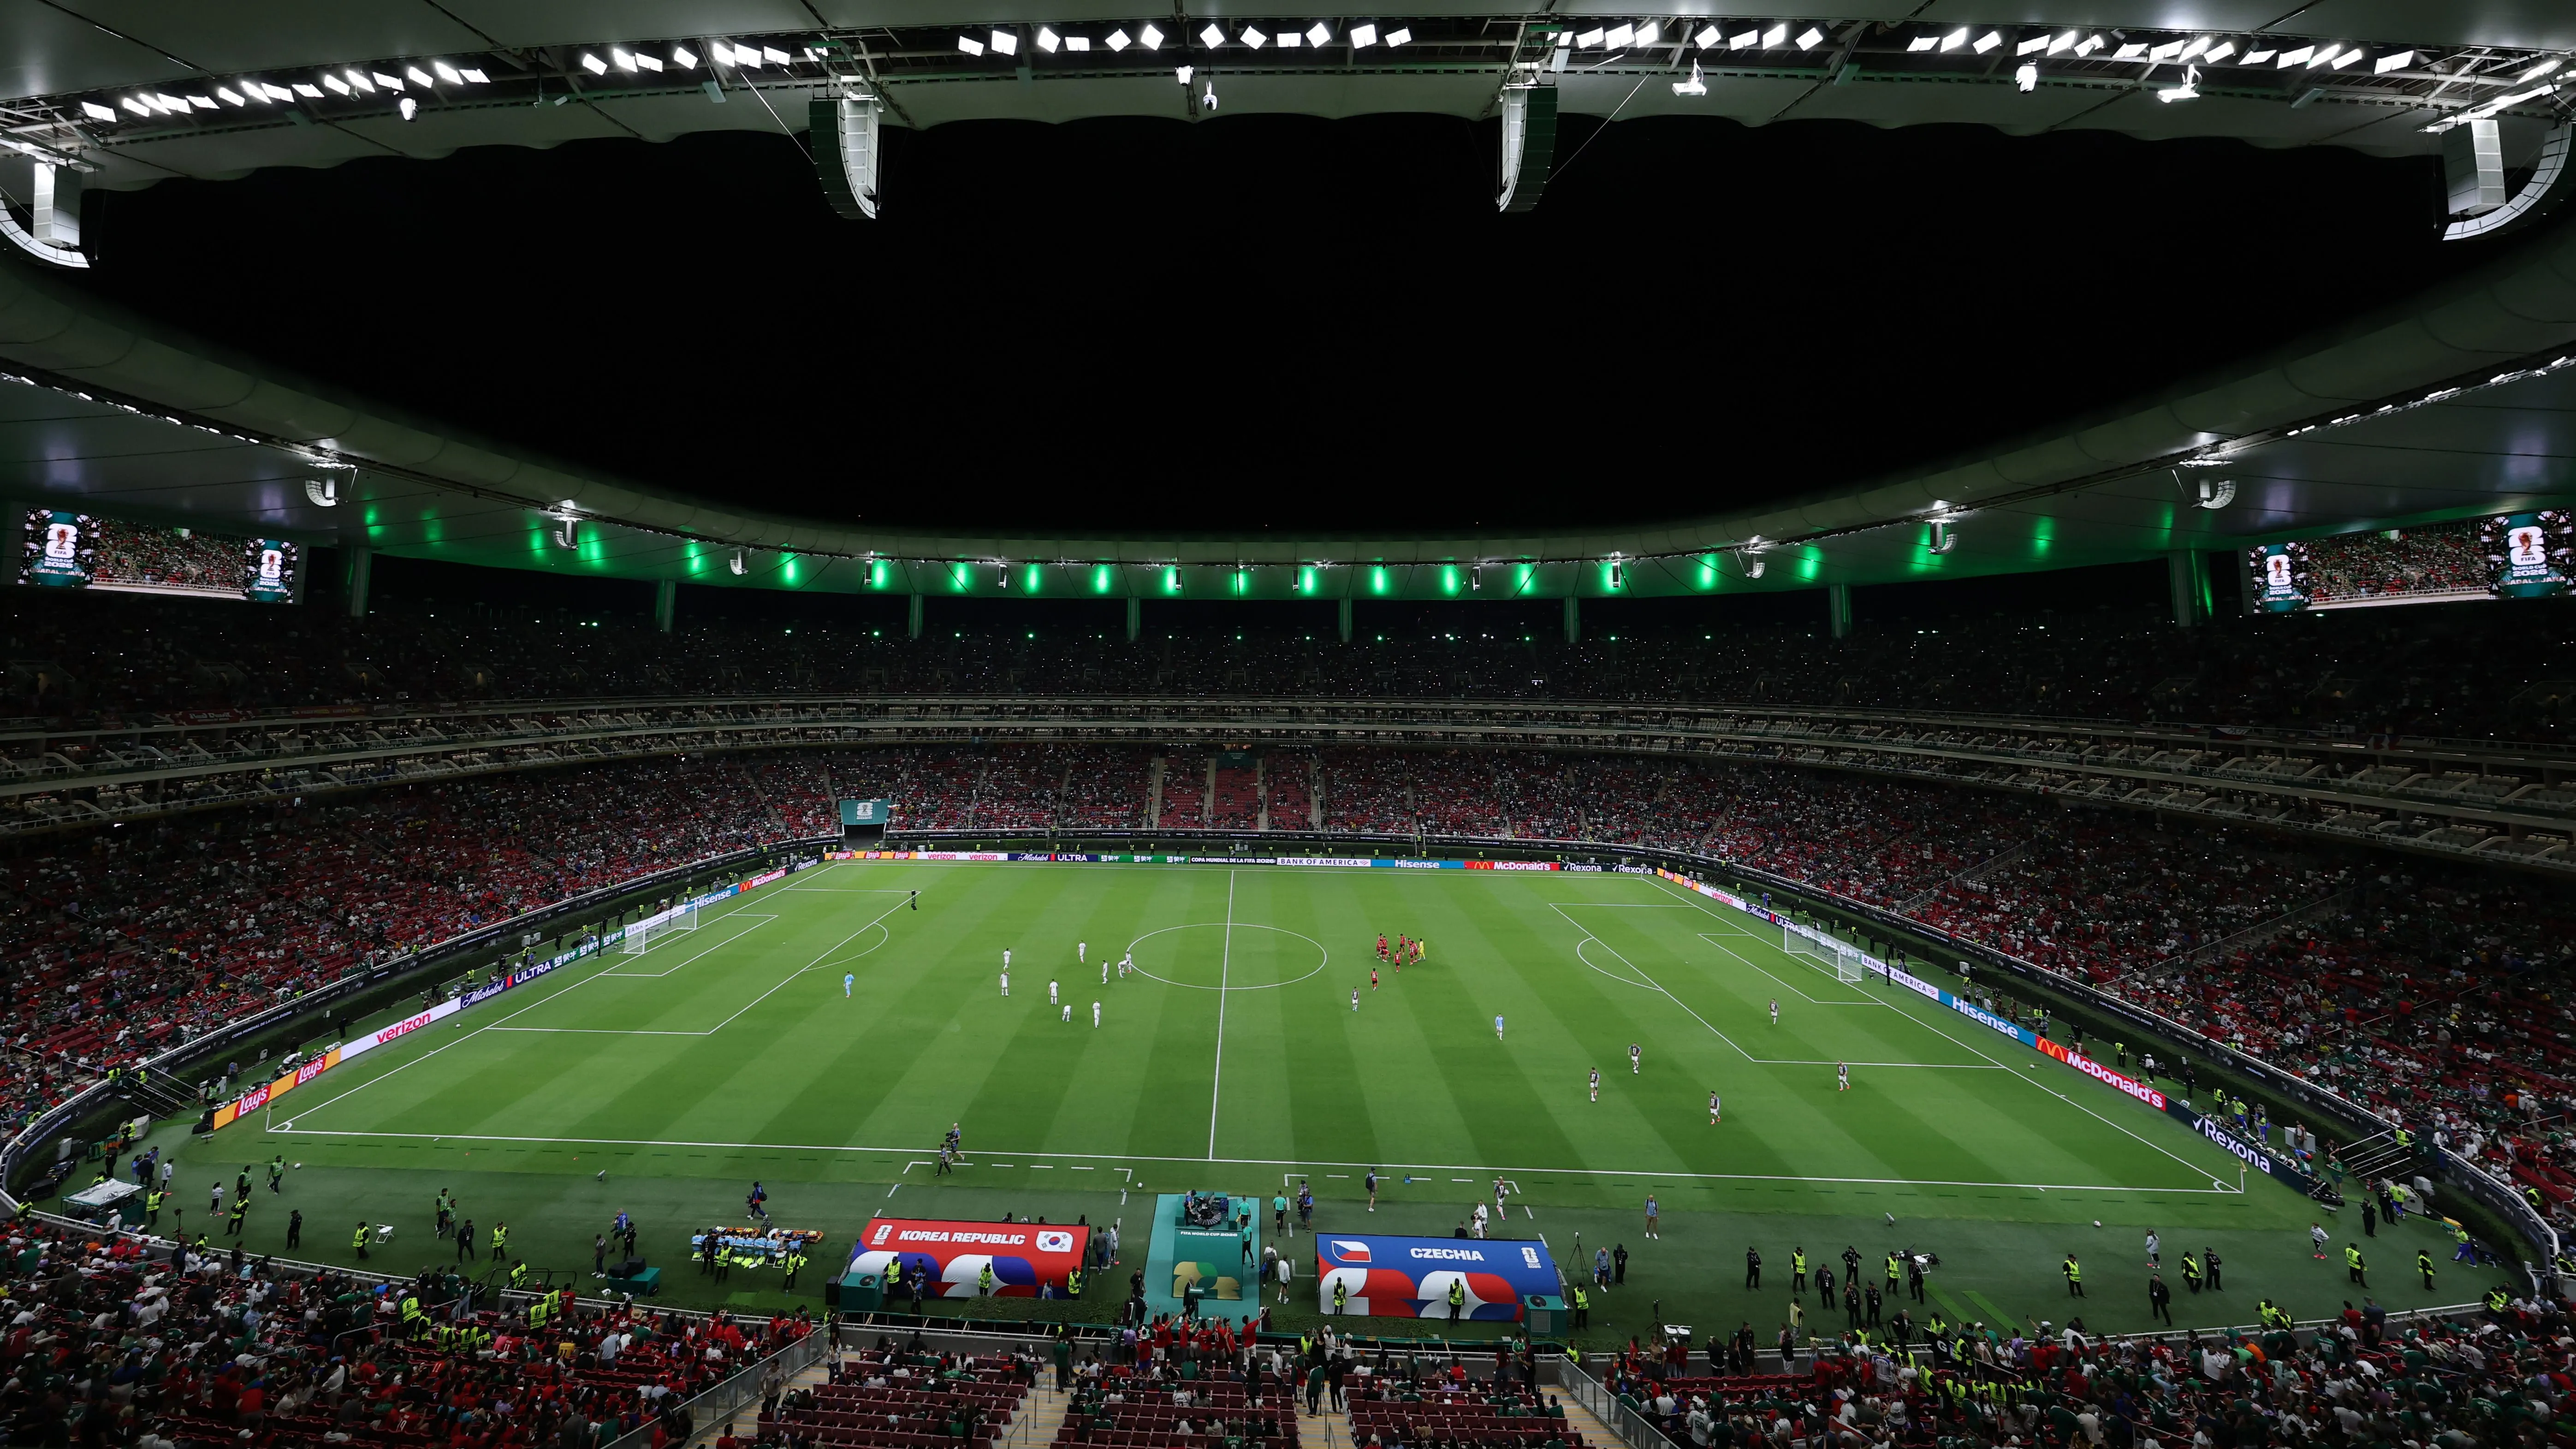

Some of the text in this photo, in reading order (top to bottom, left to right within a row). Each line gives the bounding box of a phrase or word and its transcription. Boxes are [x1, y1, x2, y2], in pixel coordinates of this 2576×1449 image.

[2202, 772, 2275, 784] GUADALAJARA
[798, 859, 817, 871] Rexona
[1395, 860, 1440, 868] Hisense
[1494, 861, 1550, 870] McDonald's
[1570, 863, 1602, 872] Rexona
[752, 869, 785, 888] McDonald's
[694, 890, 731, 909] Hisense
[1712, 891, 1733, 906] verizon
[1747, 905, 1769, 920] Michelob
[1864, 957, 1881, 970] BANK
[1894, 972, 1927, 992] AMERICA
[462, 962, 551, 1008] Michelob ULTRA
[243, 1024, 259, 1033] MUNDIAL
[279, 1010, 292, 1019] 2026
[1953, 996, 2018, 1039] Hisense
[2108, 1004, 2122, 1013] MUNDIAL
[2140, 1018, 2153, 1026] 2026
[377, 1013, 430, 1043] verizon
[298, 1058, 323, 1084] Lay's
[2067, 1051, 2163, 1108] McDonald's
[238, 1088, 267, 1116] Lay's
[59, 1114, 71, 1125] 2026
[2205, 1118, 2270, 1174] Rexona
[898, 1230, 1025, 1245] KOREA REPUBLIC
[1410, 1248, 1484, 1261] CZECHIA
[709, 1322, 713, 1332] 7
[9, 1335, 16, 1346] 7
[1937, 1340, 1947, 1352] G
